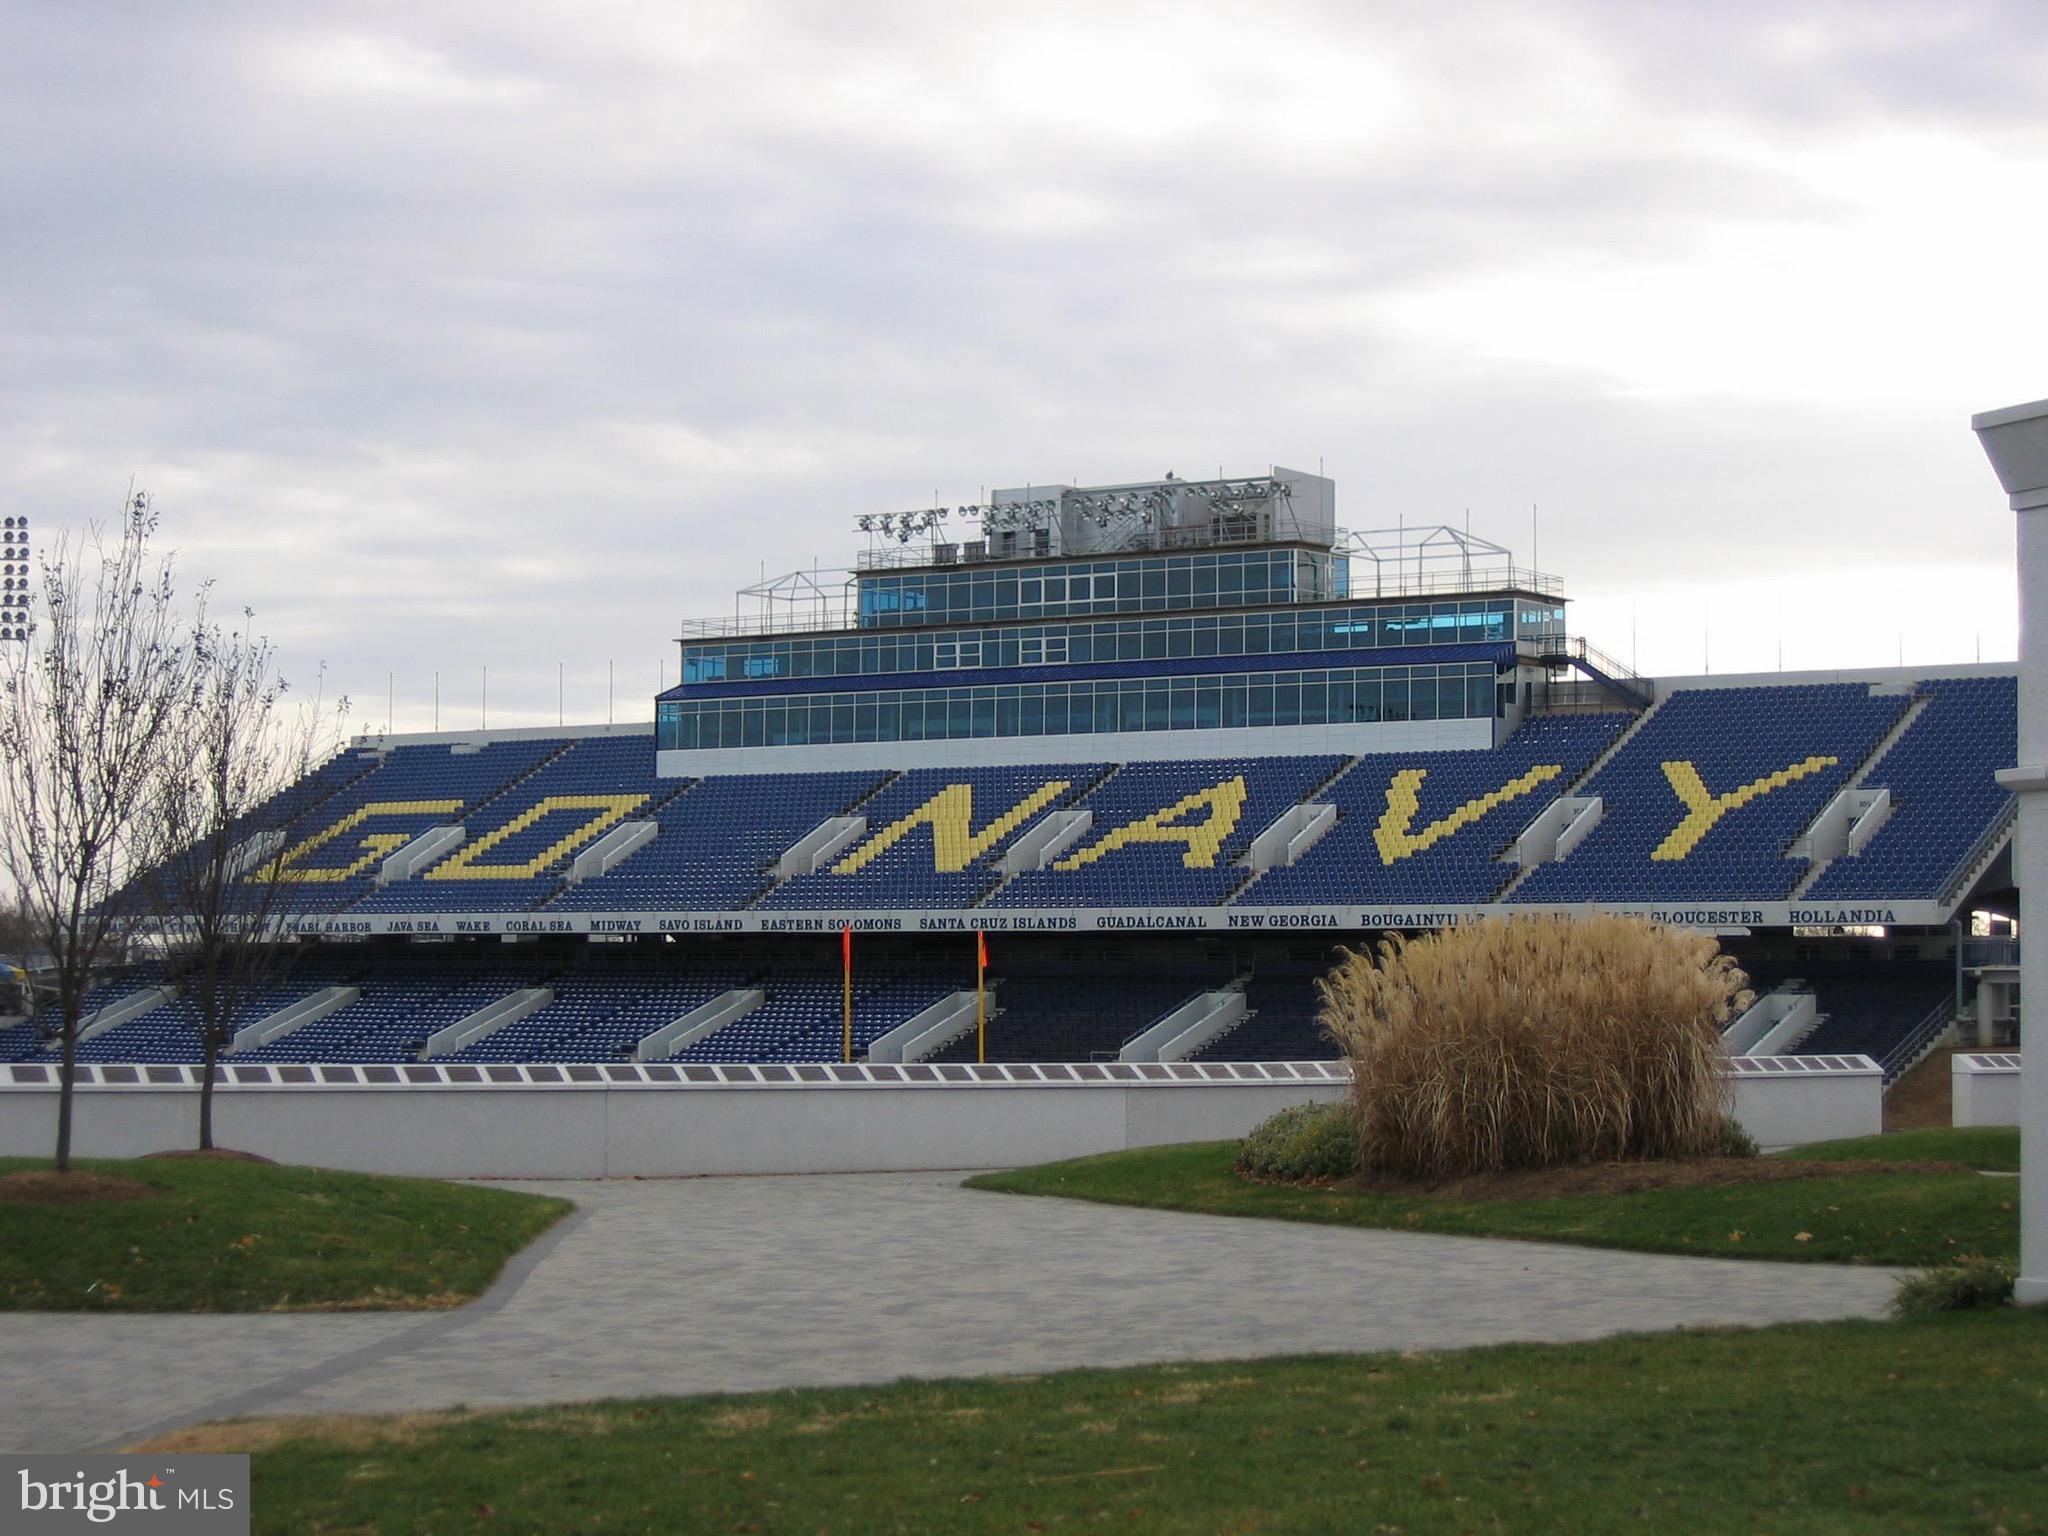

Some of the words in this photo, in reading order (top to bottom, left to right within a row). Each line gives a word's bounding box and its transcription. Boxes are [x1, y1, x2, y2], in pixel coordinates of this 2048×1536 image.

[243, 794, 650, 882] GO
[831, 755, 1839, 876] NAVY
[1096, 916, 1207, 928] GUADALCANAL
[1228, 915, 1265, 927] NEW
[1268, 914, 1338, 927] GEORGIA
[1651, 911, 1763, 924] GLOUCESTER
[1788, 909, 1896, 923] HOLLANDIA
[325, 922, 372, 933] HARBOR
[386, 921, 412, 932] JAVA
[417, 921, 439, 932] SEA
[456, 920, 491, 932] WAKE
[505, 920, 546, 931] CORAL
[549, 920, 573, 931] SEA
[590, 919, 642, 931] MIDWAY
[659, 919, 690, 931] SAVO
[693, 919, 743, 931] ISLAND
[761, 918, 823, 930] EASTERN
[828, 918, 902, 930] SOLOMONS
[919, 917, 966, 929] SANTA
[970, 917, 1008, 929] CRUZ
[1012, 917, 1077, 929] ISLANDS
